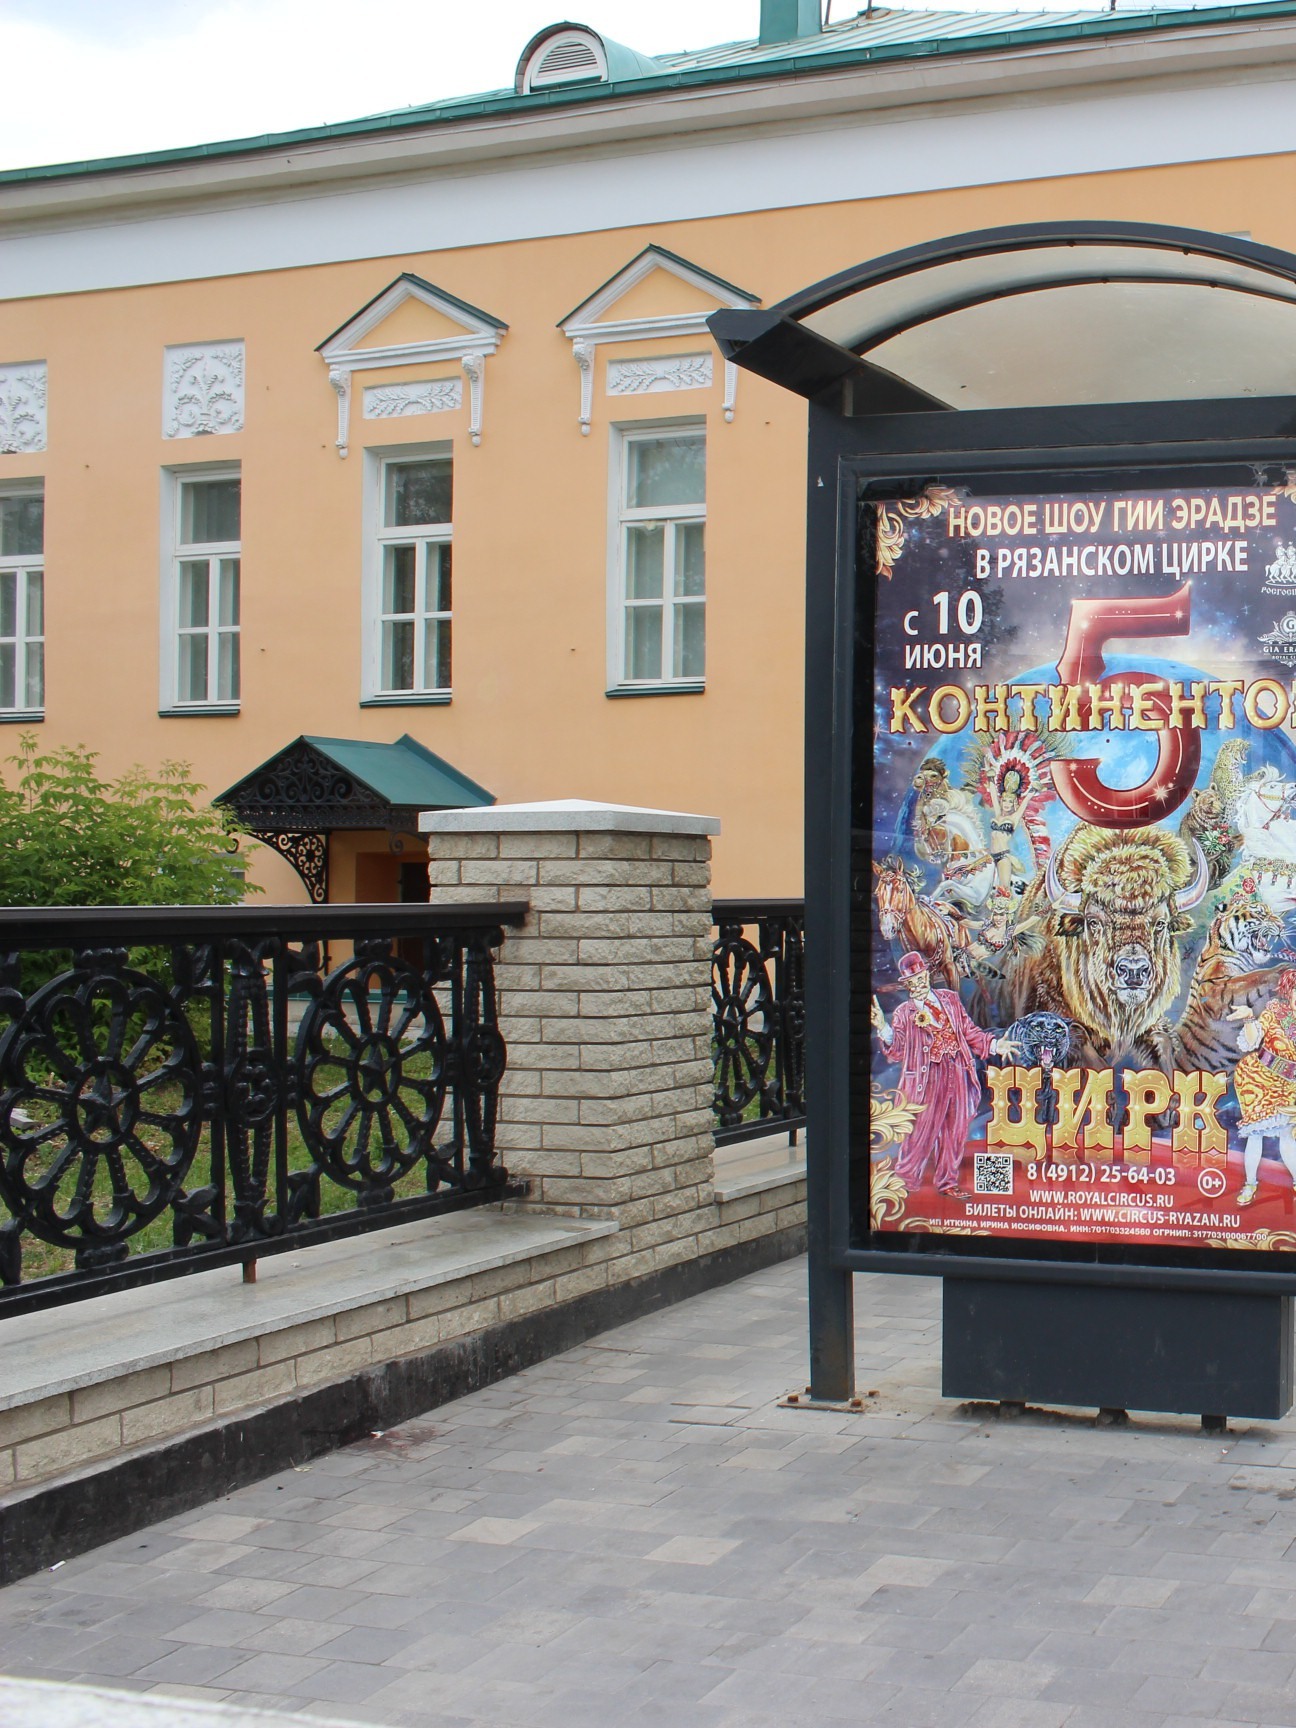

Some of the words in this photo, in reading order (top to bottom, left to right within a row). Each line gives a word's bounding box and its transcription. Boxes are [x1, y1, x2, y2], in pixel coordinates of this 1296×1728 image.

[948, 504, 1038, 538] НОВОЕ
[1045, 499, 1104, 534] ШОУ
[1112, 498, 1165, 532] ГИИ
[1172, 494, 1276, 533] ЭРАДЗЕ
[976, 552, 990, 580] В
[997, 542, 1154, 578] РЯЗАНСКОМ
[1160, 541, 1248, 580] ЦИРКЕ
[932, 590, 983, 635] 10
[1056, 580, 1192, 830] 5
[986, 1064, 1230, 1160] ЦИРК
[1027, 1163, 1038, 1182] 8
[1040, 1161, 1096, 1184] (4912)
[1100, 1164, 1176, 1186] 25-64-03
[1202, 1174, 1222, 1191] 0+
[1029, 1188, 1174, 1208] WWW.ROYALCIRCUS.RU
[943, 1219, 978, 1228] ИТКИНА
[980, 1220, 1009, 1230] ИРИНА
[1153, 1229, 1192, 1238] ОГРНИП:
[965, 1203, 1016, 1218] БИЛЕТЫ
[1019, 1206, 1078, 1221] ОНЛАЙН:
[1080, 1208, 1240, 1228] WWW.CIRCUS-RYAZAN.RU
